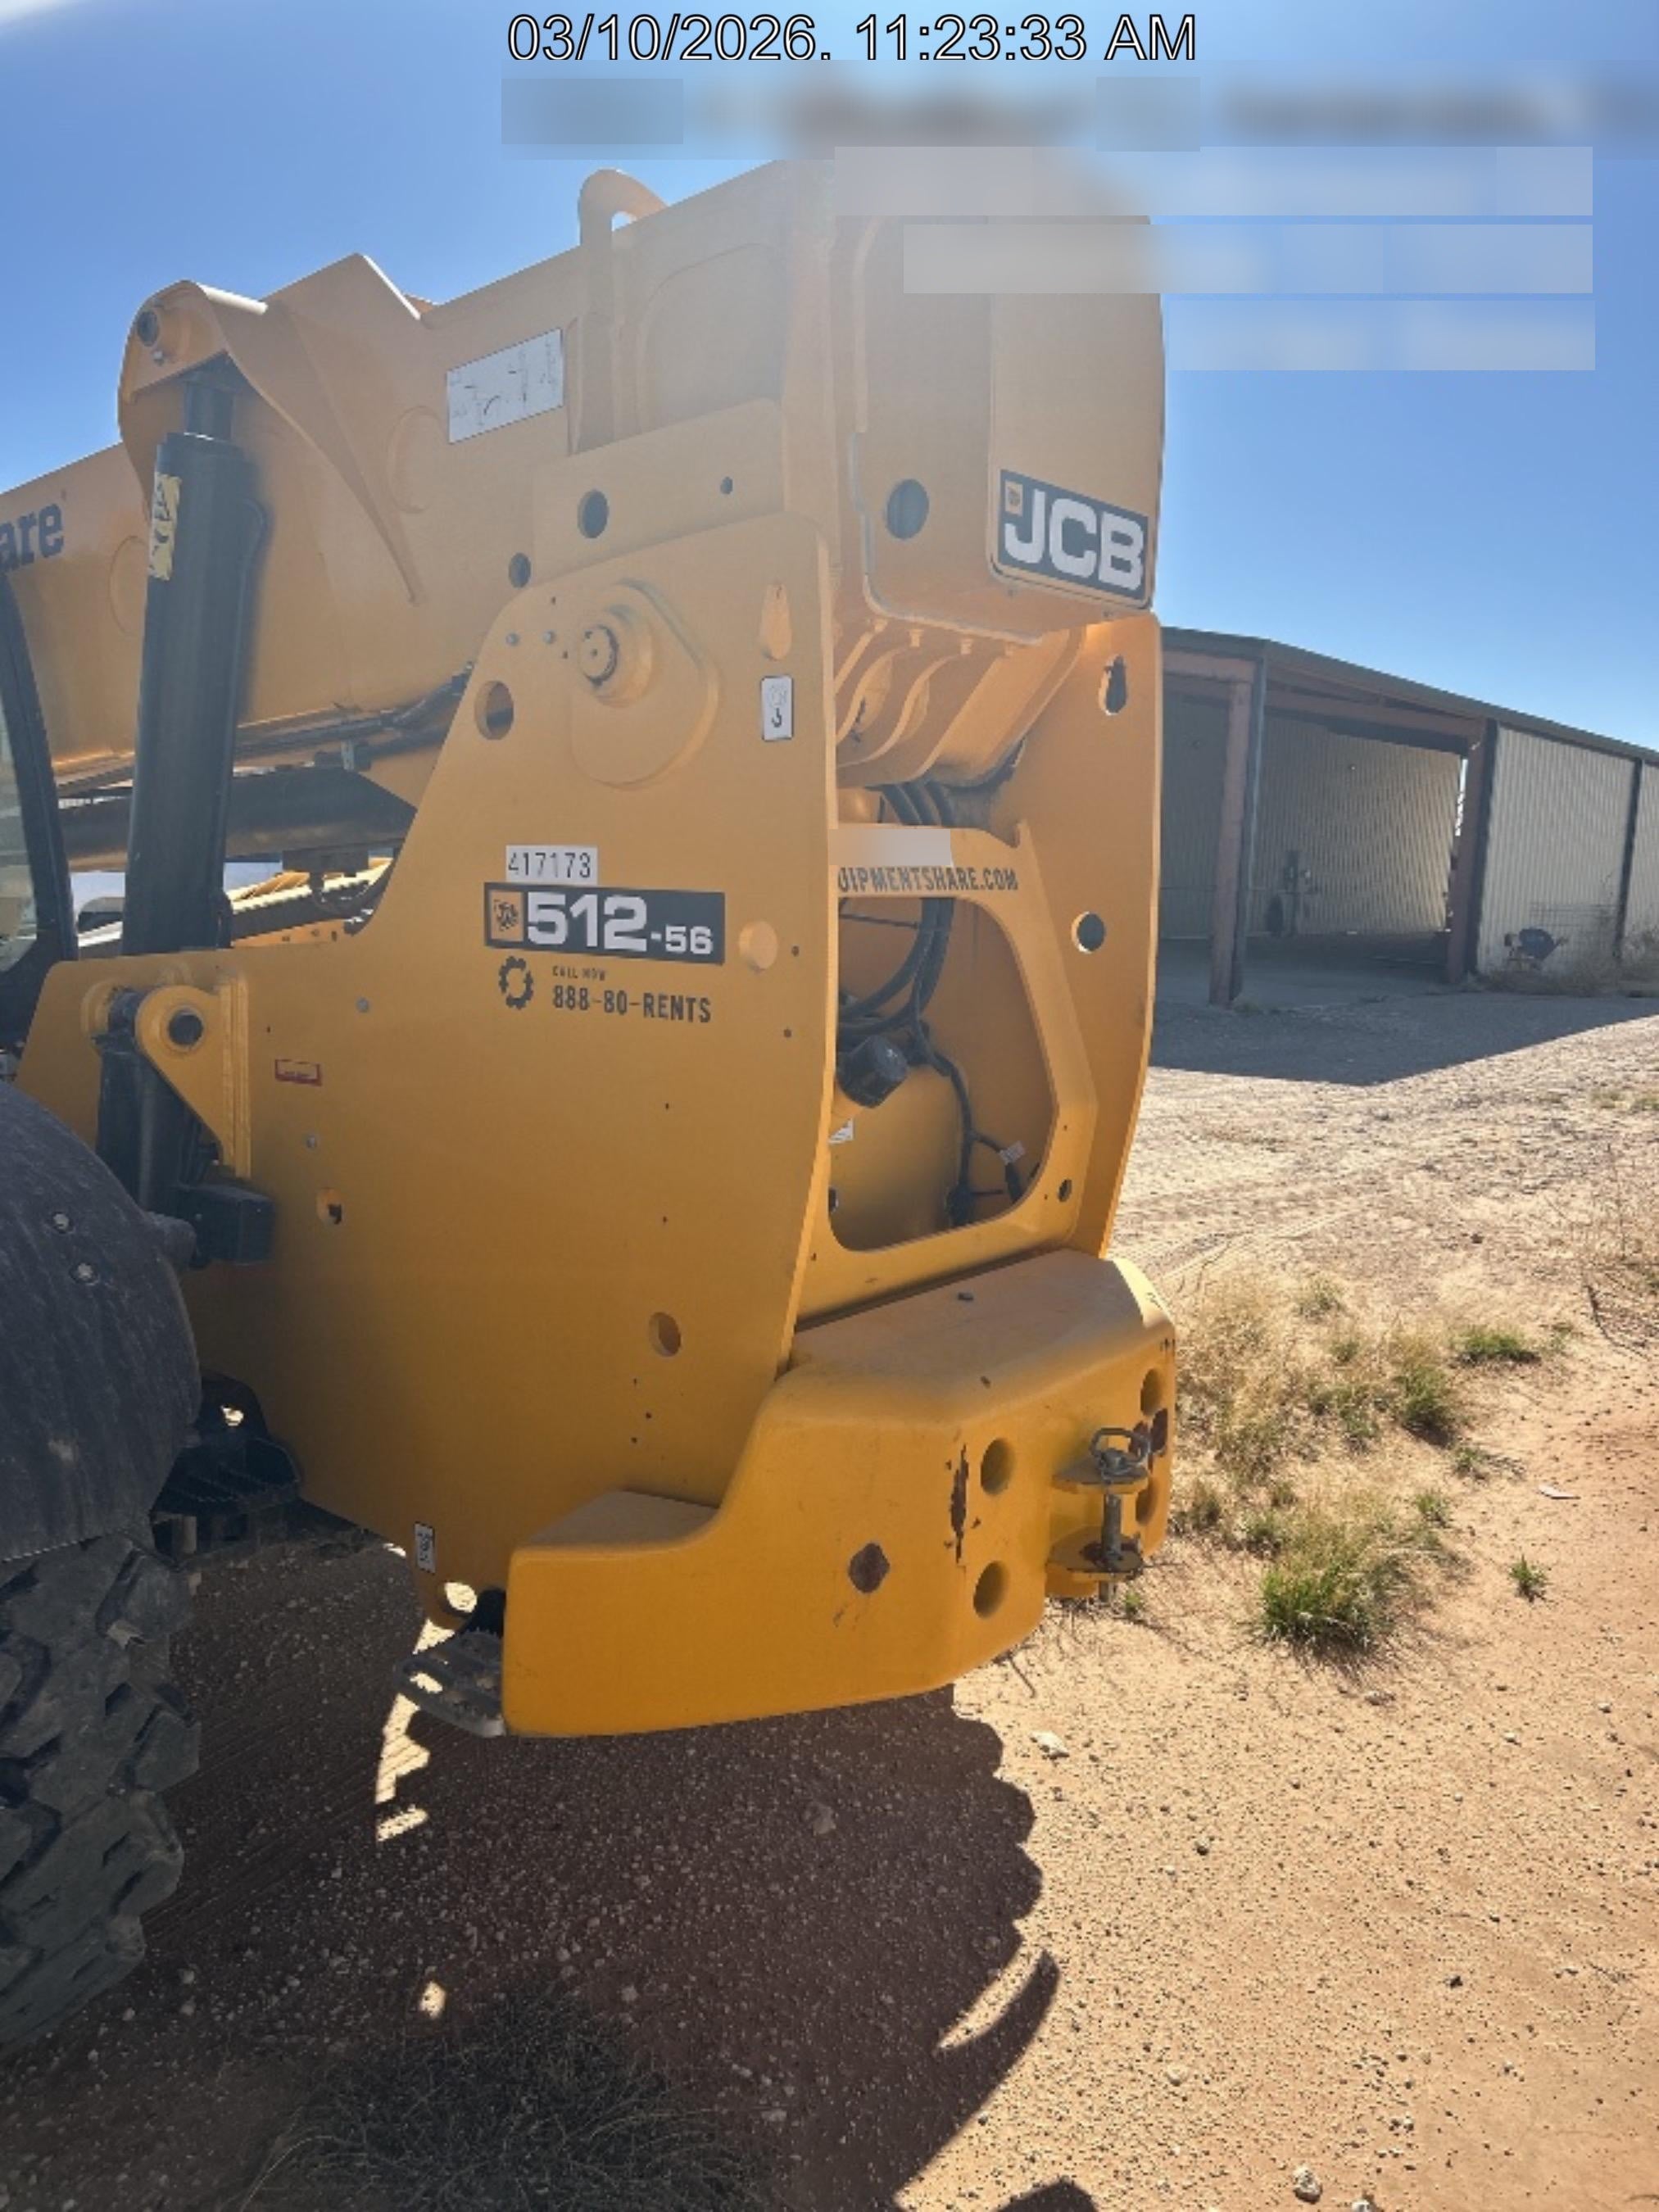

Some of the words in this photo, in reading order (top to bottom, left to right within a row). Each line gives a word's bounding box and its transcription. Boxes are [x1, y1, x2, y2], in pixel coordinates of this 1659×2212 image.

[1004, 488, 1145, 591] JCB
[508, 852, 591, 878] 417173
[527, 891, 714, 955] 512-56
[552, 965, 578, 979] CALL
[552, 985, 712, 1023] 888-80-RENTS
